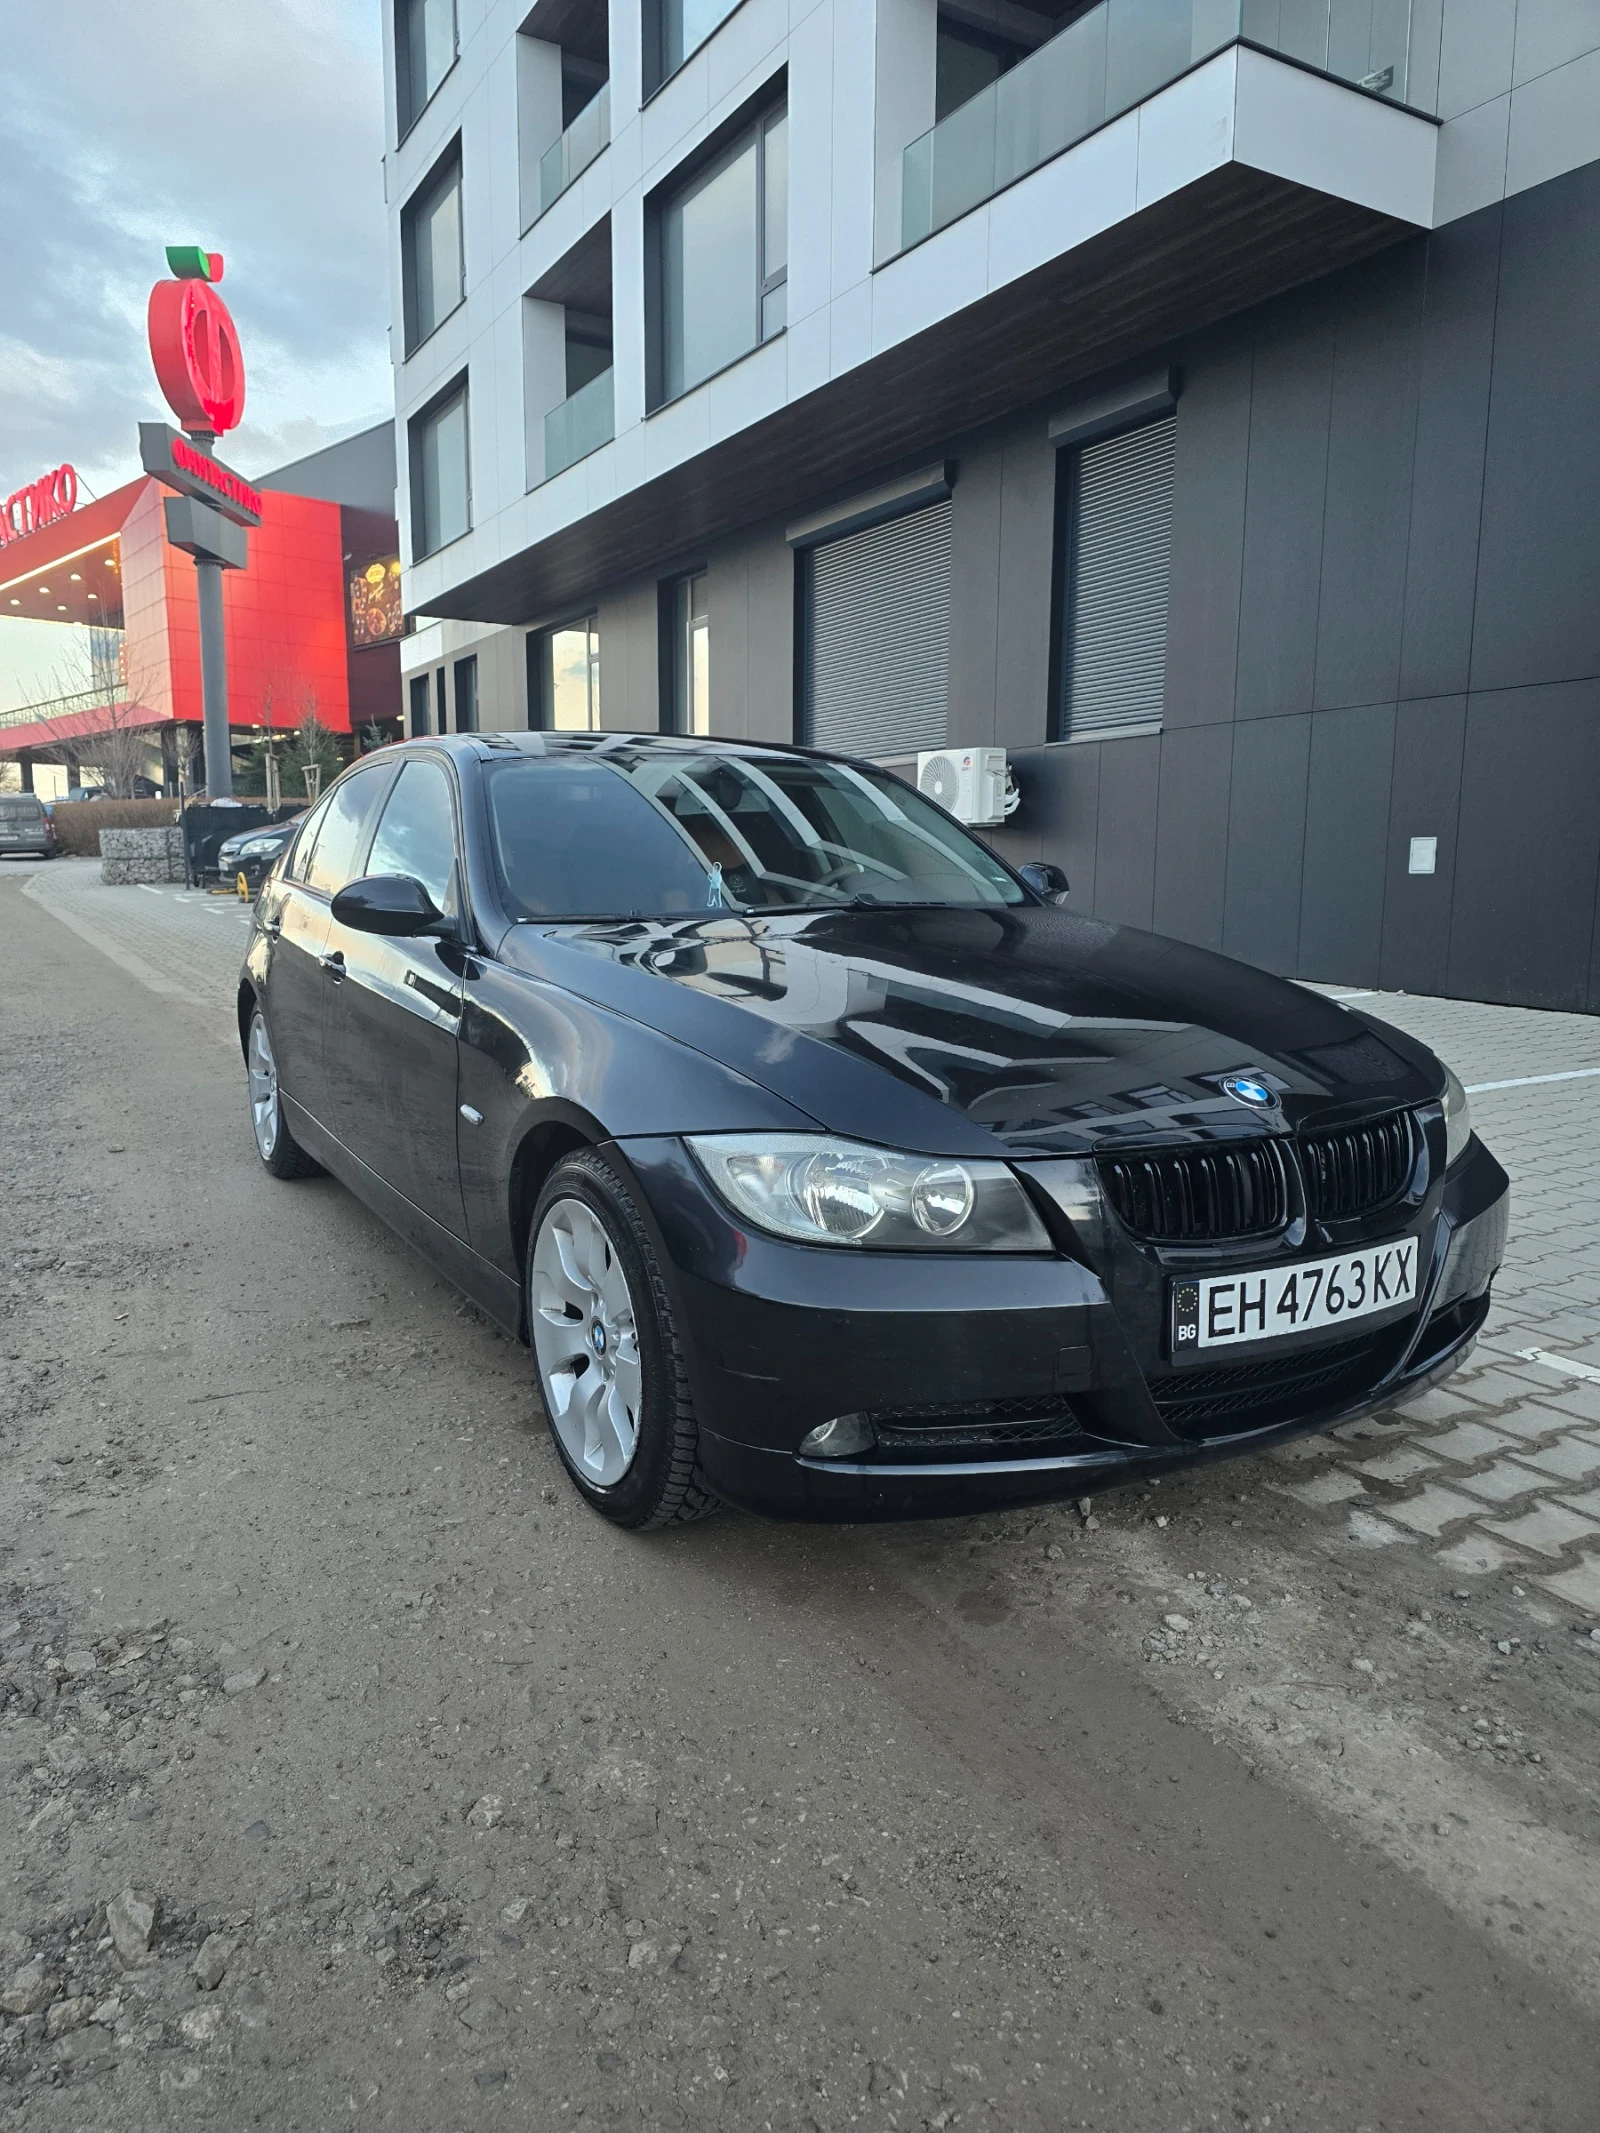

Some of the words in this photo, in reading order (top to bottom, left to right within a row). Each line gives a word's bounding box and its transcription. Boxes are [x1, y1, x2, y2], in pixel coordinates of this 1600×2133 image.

[171, 436, 262, 517] ФАНТАСТИКО
[1177, 1323, 1197, 1341] BG
[1207, 1278, 1267, 1339] EH
[1276, 1259, 1366, 1325] 4763
[1373, 1245, 1413, 1304] KX
